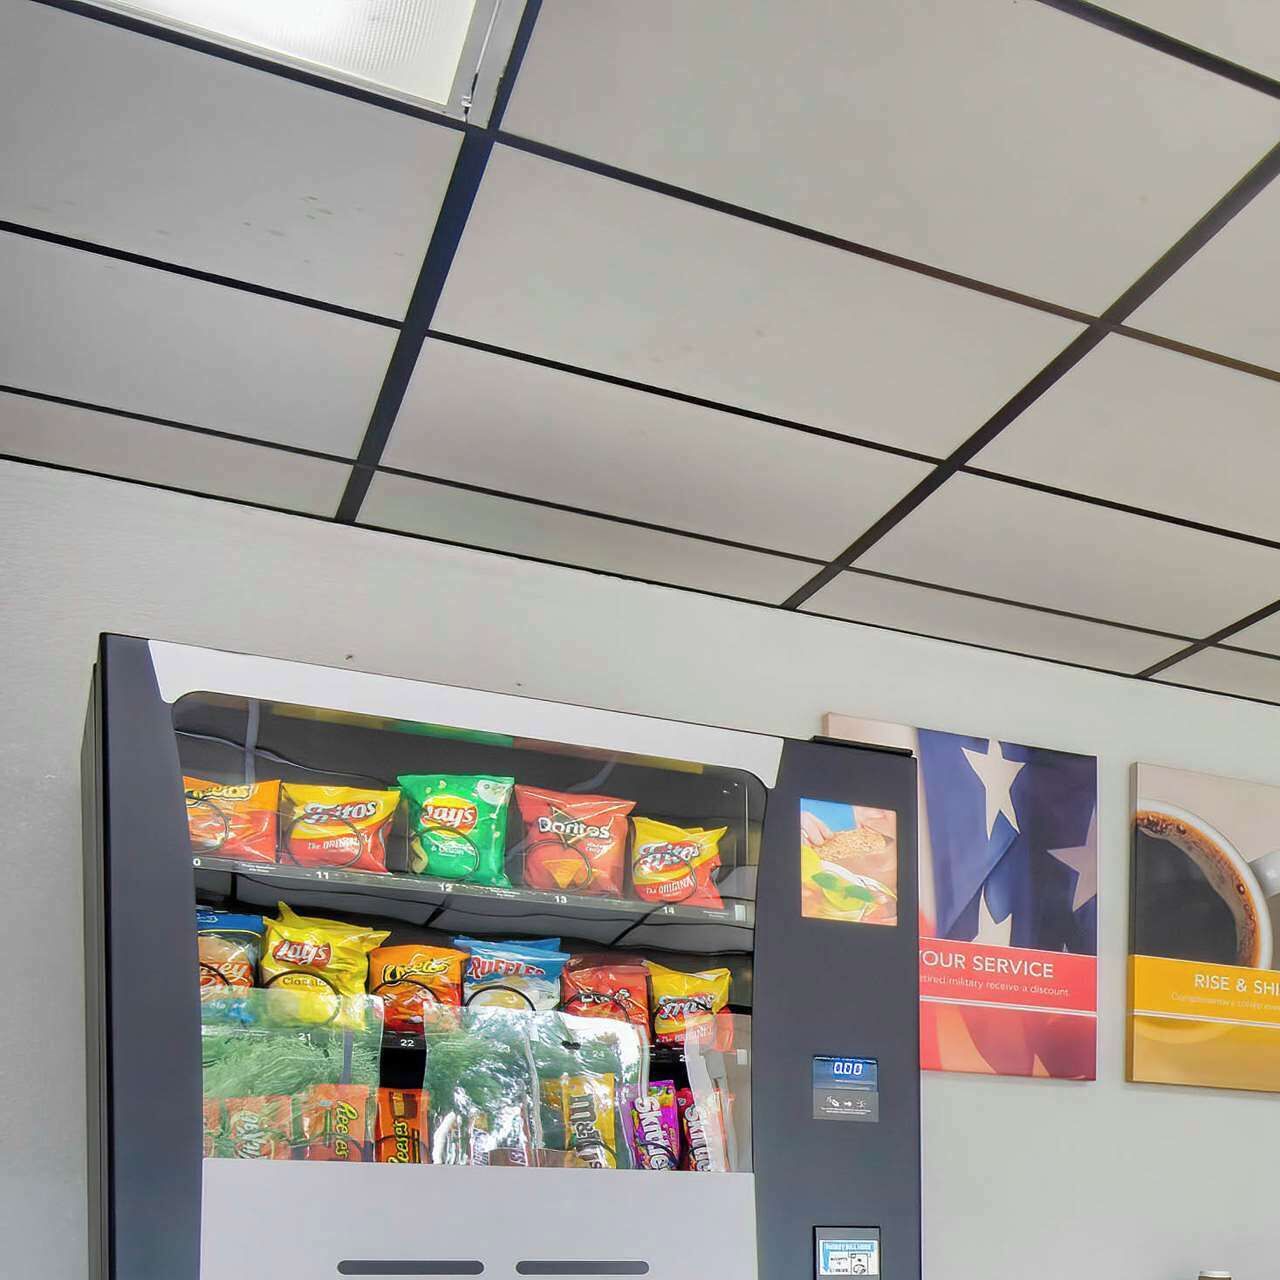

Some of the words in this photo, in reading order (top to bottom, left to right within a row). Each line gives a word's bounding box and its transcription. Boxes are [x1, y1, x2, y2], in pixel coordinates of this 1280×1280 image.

[537, 816, 611, 839] Doritos
[662, 906, 675, 914] 14
[972, 955, 1054, 978] SERVICE
[986, 982, 1020, 992] receive
[1194, 974, 1230, 991] RISE
[1236, 978, 1248, 992] &
[400, 1038, 415, 1048] 22
